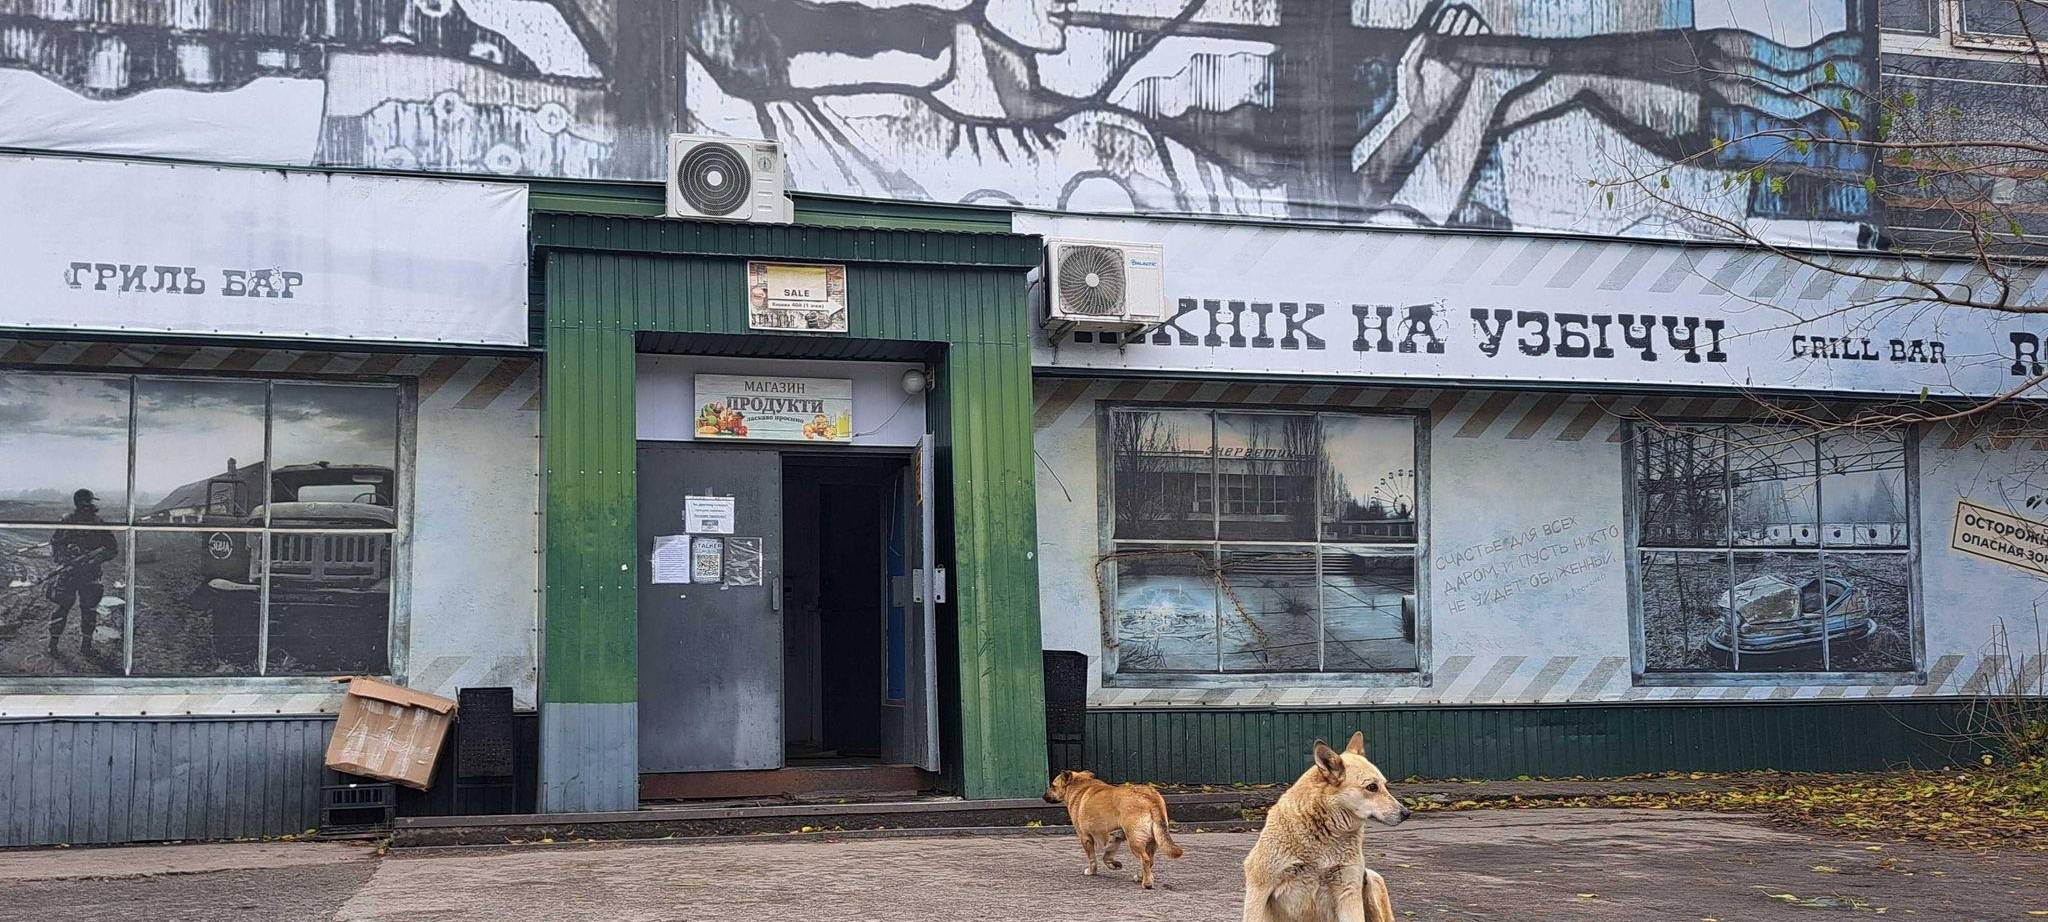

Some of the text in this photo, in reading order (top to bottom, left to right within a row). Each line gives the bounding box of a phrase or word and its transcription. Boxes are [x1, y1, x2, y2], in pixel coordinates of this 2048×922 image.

[64, 262, 303, 299] ГРИЛЬ БАР
[784, 289, 810, 297] SALE
[1073, 298, 1727, 363] КНІК НА УЗБІЧЧІ
[1792, 335, 1947, 364] GRILL BAR
[744, 381, 805, 394] МАГАЗИН
[726, 397, 824, 414] ПРОДУКТИ
[1510, 527, 1537, 551] ДЛЯ
[1542, 516, 1578, 536] ВСЕХ
[1573, 525, 1619, 551] НИКТО
[1961, 532, 2024, 558] ОПАСНАЯ
[1448, 599, 1466, 616] НЕ
